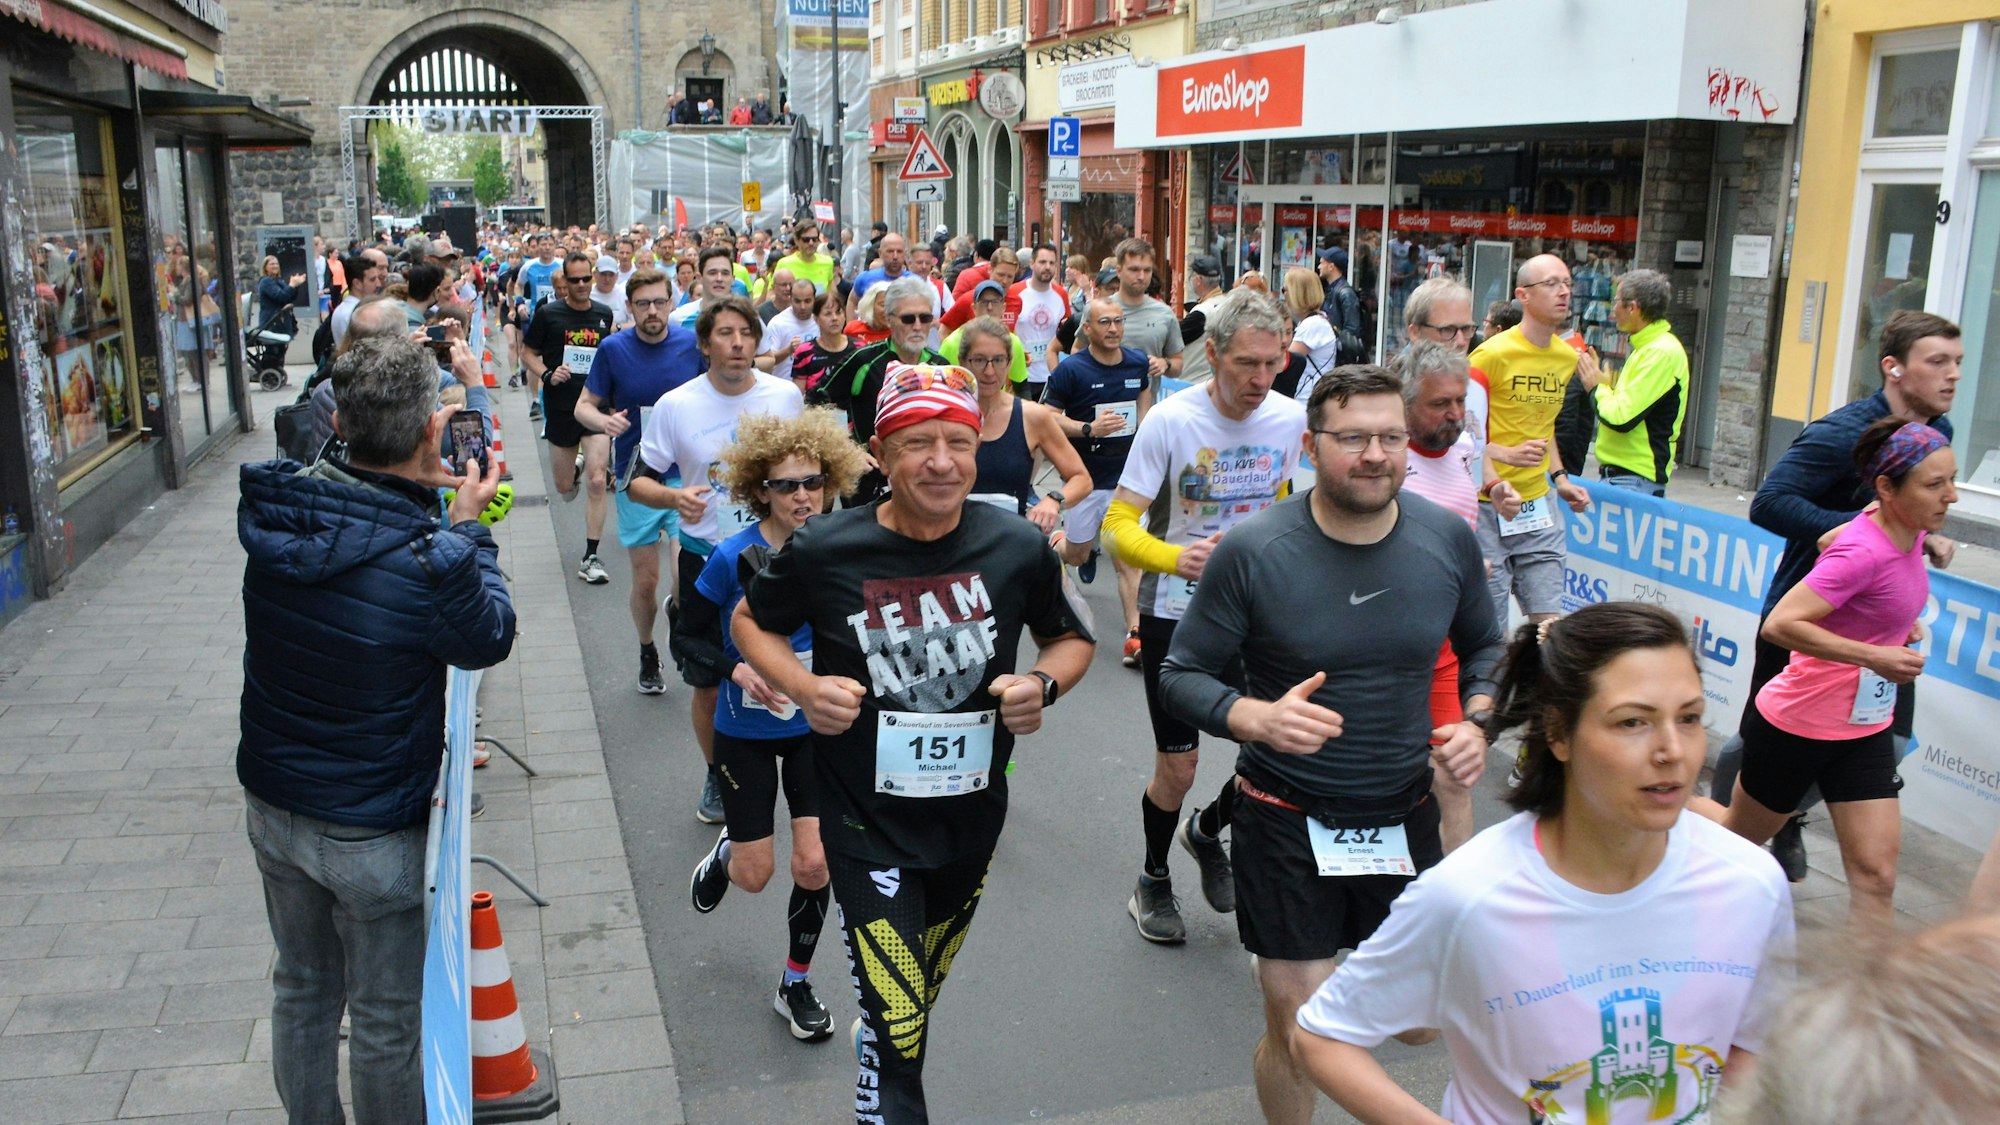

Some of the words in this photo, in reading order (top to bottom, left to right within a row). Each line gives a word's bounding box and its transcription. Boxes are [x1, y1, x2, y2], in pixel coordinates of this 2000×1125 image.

[1183, 67, 1270, 118] EuroShop
[424, 109, 531, 133] START
[888, 124, 907, 134] DER
[1053, 122, 1071, 152] P
[1398, 213, 1430, 226] EuroShop
[1936, 201, 1951, 224] 9
[1450, 215, 1485, 229] EuroShop
[1507, 217, 1546, 233] EuroShop
[1571, 219, 1615, 236] EuroShop
[573, 353, 591, 363] 398
[1212, 461, 1232, 472] 30.
[1235, 458, 1255, 470] KVB
[1212, 470, 1271, 485] Dauerlauf
[1571, 500, 1785, 599] SEVERIN
[847, 574, 992, 654] TEAM
[866, 615, 998, 698] ALAAF
[897, 720, 931, 728] Dauerlauf
[908, 735, 966, 760] 151
[918, 763, 957, 772] Michael
[1333, 828, 1383, 844] 232
[1485, 996, 1513, 1015] 37.
[1514, 965, 1604, 1006] Dauerlauf
[1609, 963, 1633, 979] im
